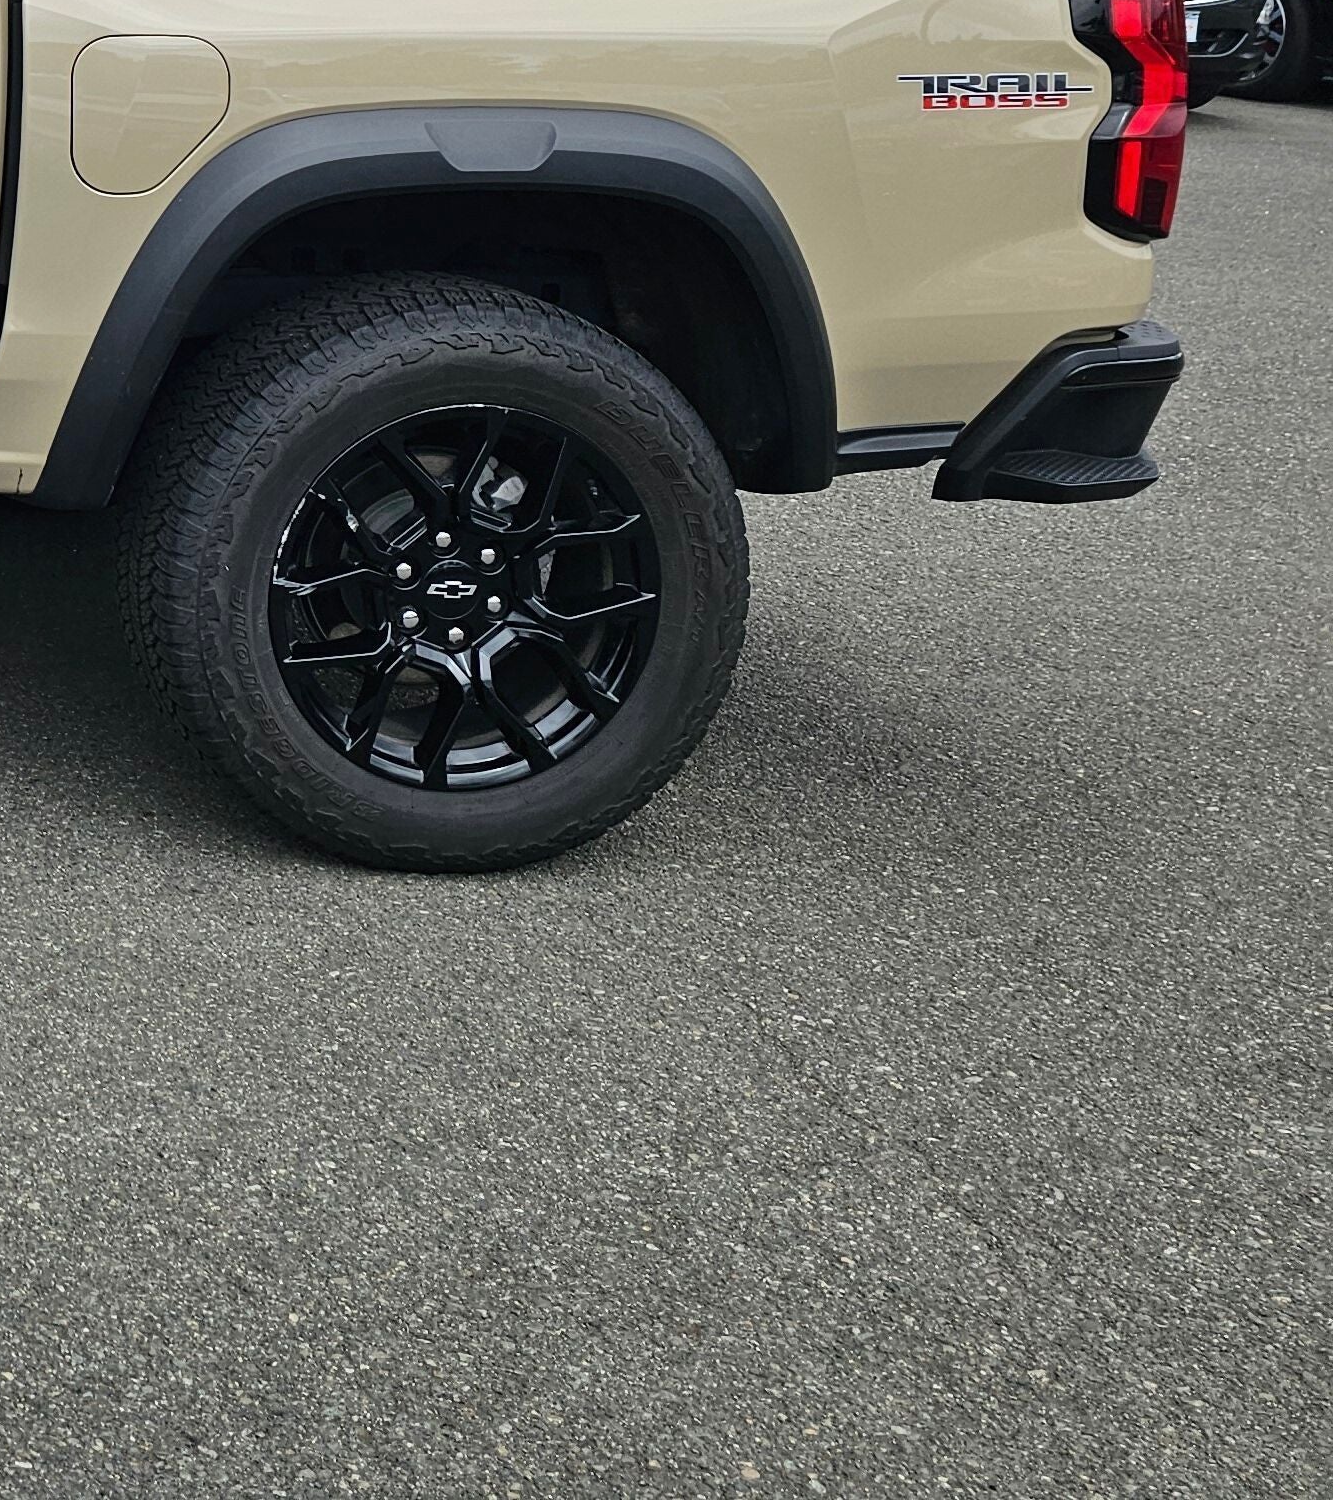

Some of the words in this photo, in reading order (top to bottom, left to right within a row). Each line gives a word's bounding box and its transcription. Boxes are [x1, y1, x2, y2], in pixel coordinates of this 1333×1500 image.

[897, 73, 1093, 94] TRAIL
[922, 92, 1069, 111] BOSS
[592, 390, 716, 579] DUELER
[217, 583, 386, 825] BRIDGESTONE
